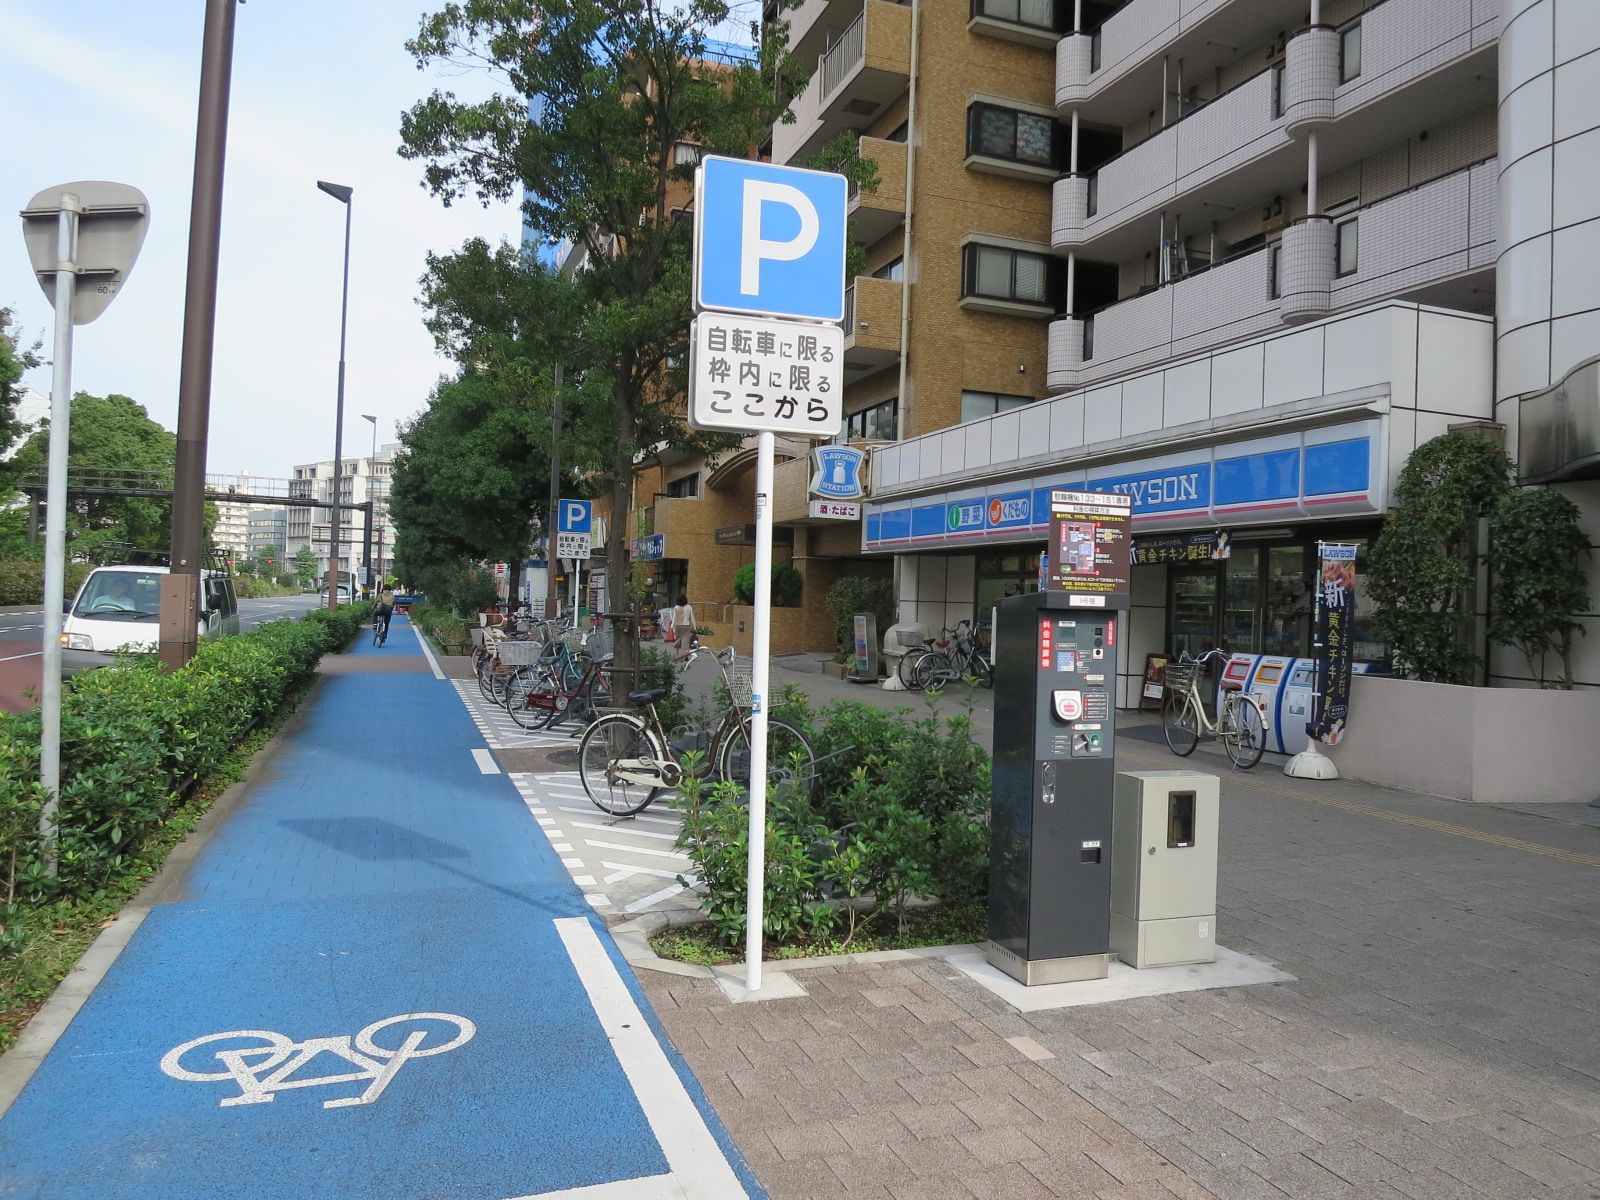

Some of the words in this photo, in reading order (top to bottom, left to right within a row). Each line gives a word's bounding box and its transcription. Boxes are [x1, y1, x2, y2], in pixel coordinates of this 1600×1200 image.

[740, 178, 820, 296] P
[707, 326, 834, 364] 自転車に限る
[708, 357, 832, 394] 枠内に限る
[710, 389, 829, 422] ここから
[823, 453, 857, 462] LAWSON
[821, 482, 856, 491] STATION
[566, 503, 586, 530] P
[1002, 500, 1029, 519] くだもの
[1324, 549, 1355, 558] LAWSON
[1324, 578, 1345, 609] 新
